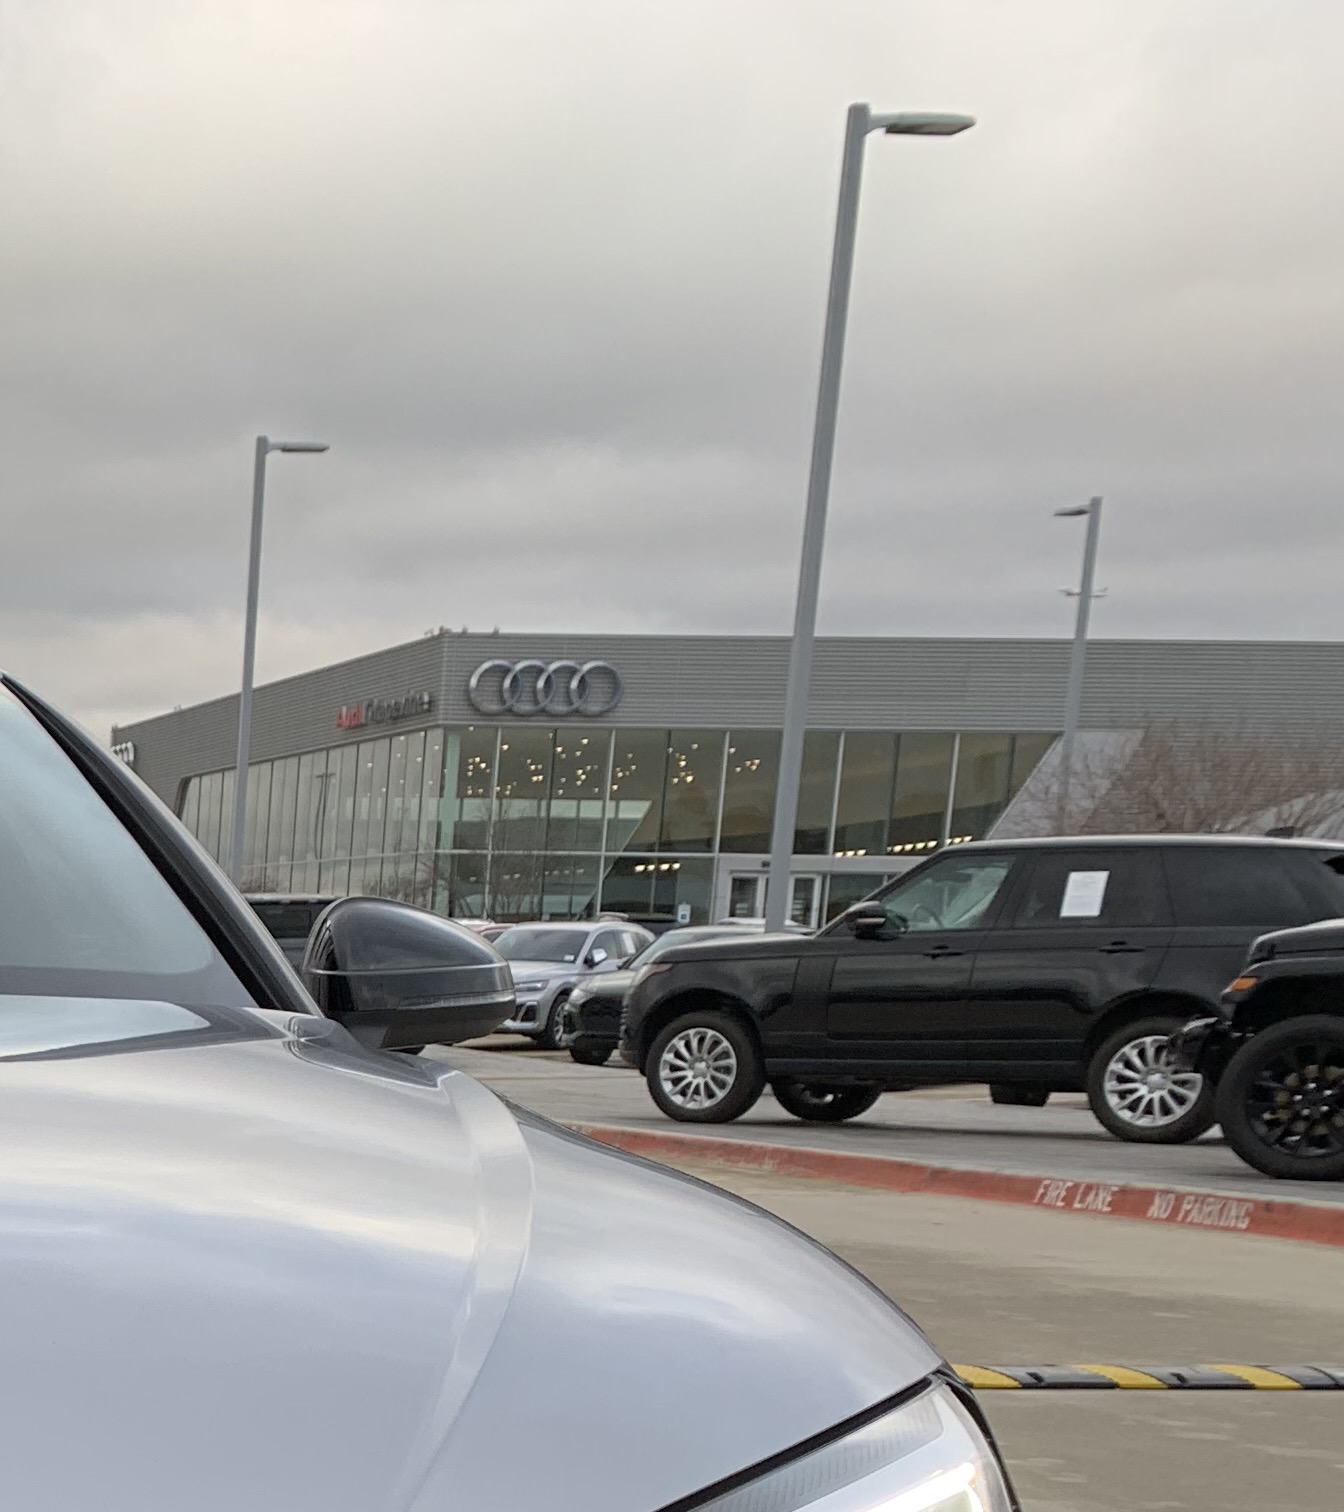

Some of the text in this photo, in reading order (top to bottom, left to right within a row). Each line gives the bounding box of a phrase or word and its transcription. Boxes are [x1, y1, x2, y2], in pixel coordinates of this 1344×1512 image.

[1033, 1179, 1254, 1229] FIRE LANE NO PARKING
